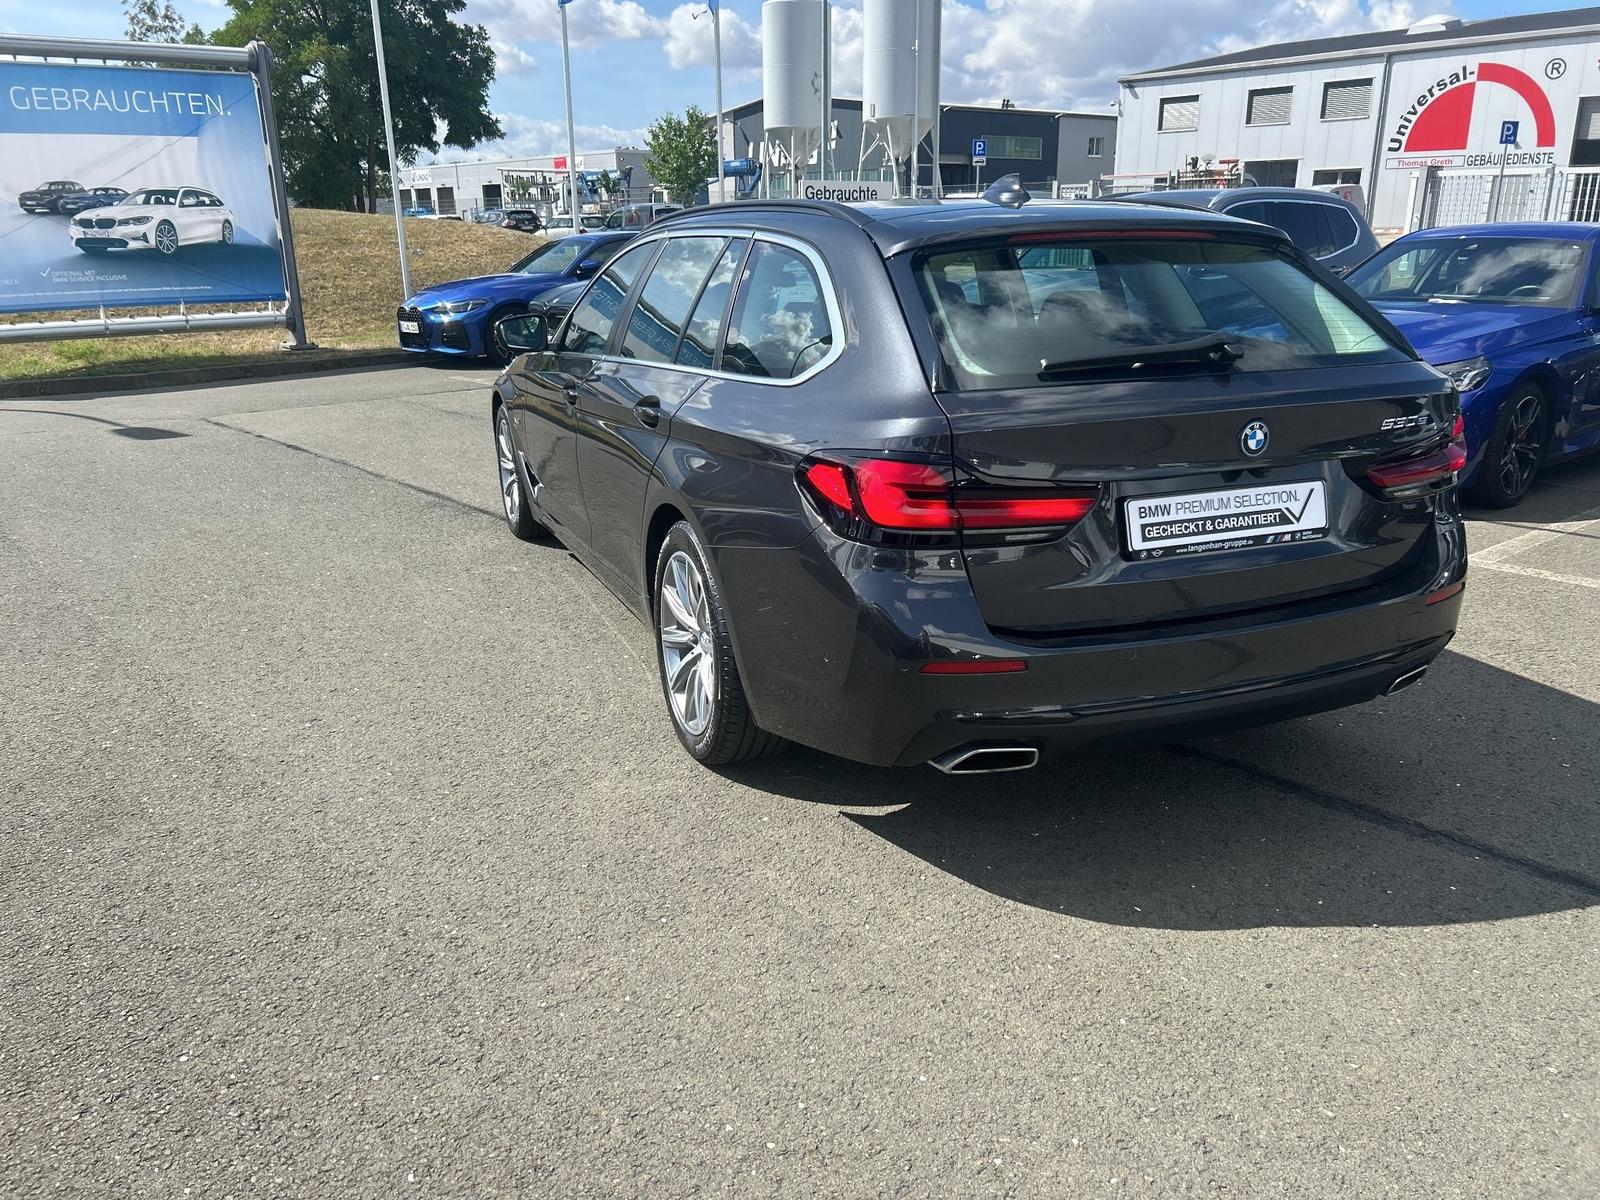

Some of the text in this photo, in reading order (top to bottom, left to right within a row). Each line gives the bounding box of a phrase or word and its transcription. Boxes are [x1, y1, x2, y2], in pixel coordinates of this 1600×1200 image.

[9, 86, 232, 117] GEBRAUCHTEN.
[1387, 65, 1475, 153] Universal-
[1502, 123, 1514, 142] P
[1397, 157, 1453, 168] Thomas Greth
[805, 185, 878, 201] Gebrauchte
[1138, 489, 1300, 519] BMW PREMIUM SELECTION.
[1144, 511, 1281, 538] GECHECKT & GARANTIERT
[1176, 538, 1254, 554] www.langenhan-gruppe.de
